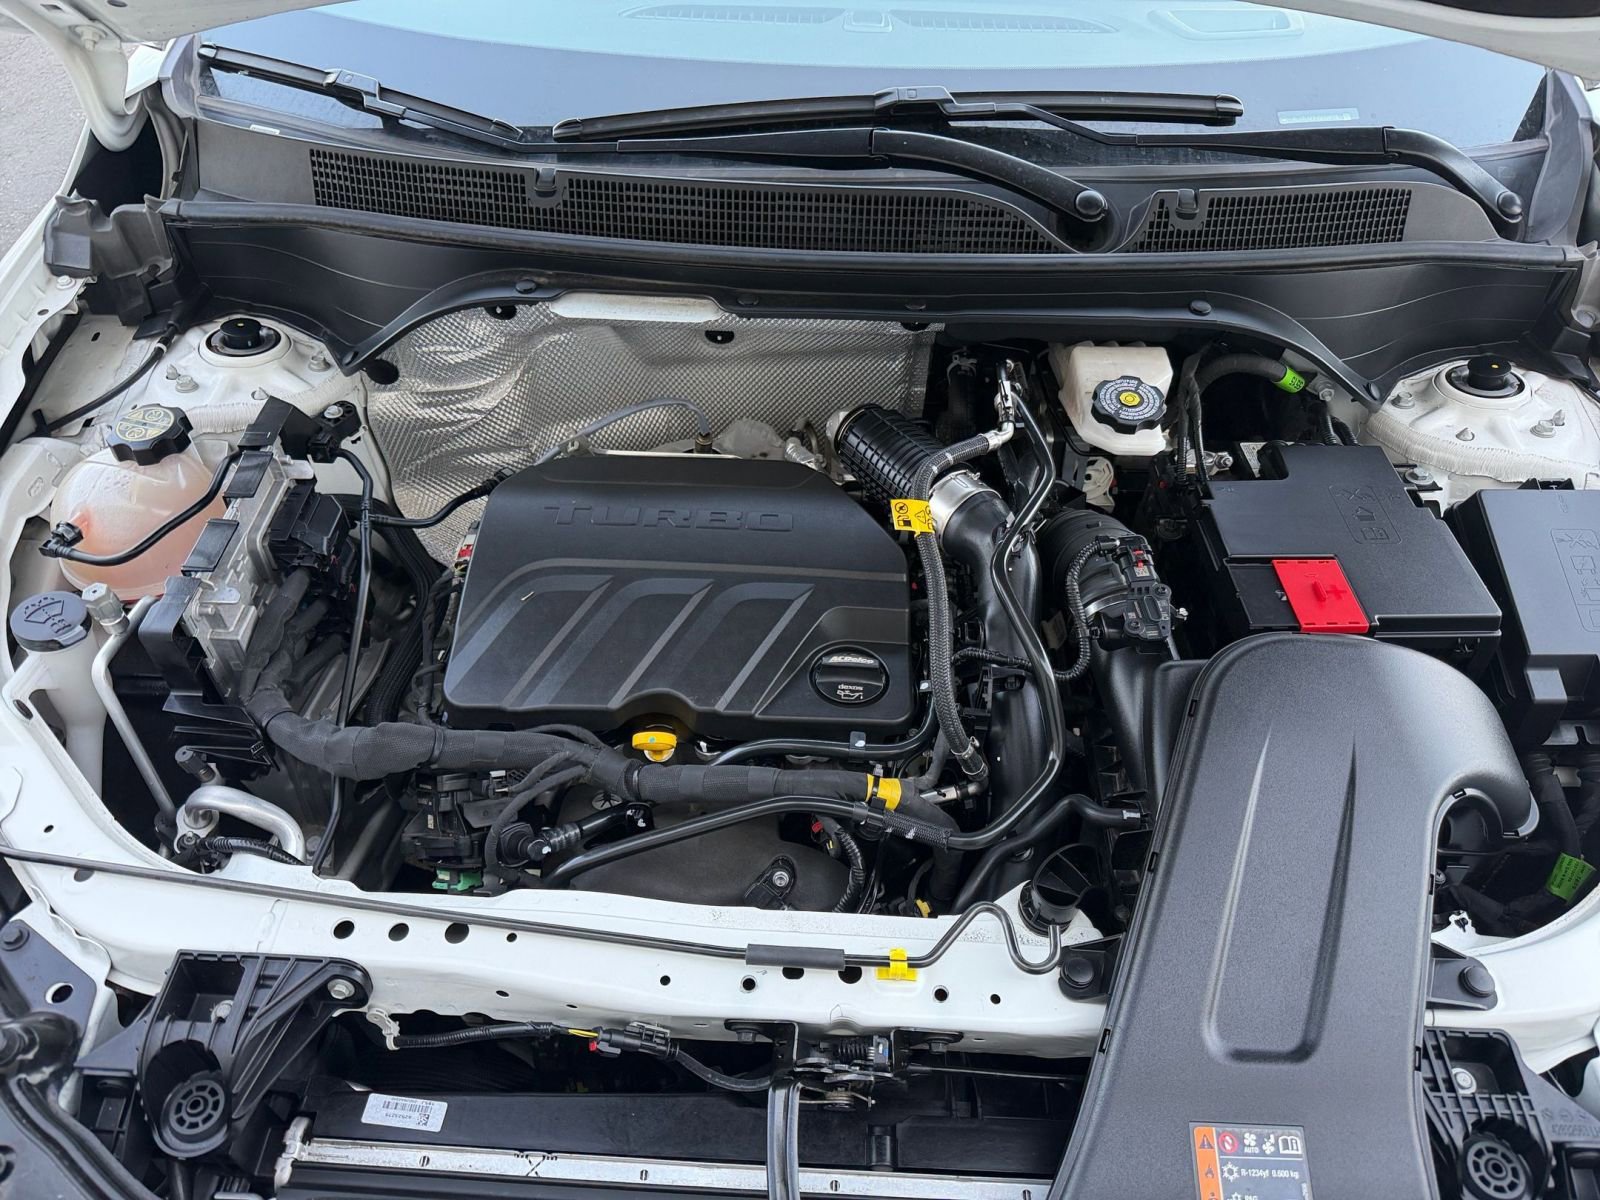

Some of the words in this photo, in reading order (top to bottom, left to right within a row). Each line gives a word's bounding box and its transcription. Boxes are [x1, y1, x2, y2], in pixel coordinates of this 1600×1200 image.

[544, 505, 794, 532] TURBO
[828, 656, 875, 664] ACDelco
[1244, 1146, 1259, 1154] AUTO
[1240, 1168, 1269, 1179] R-1234yf
[1290, 1170, 1299, 1180] kg
